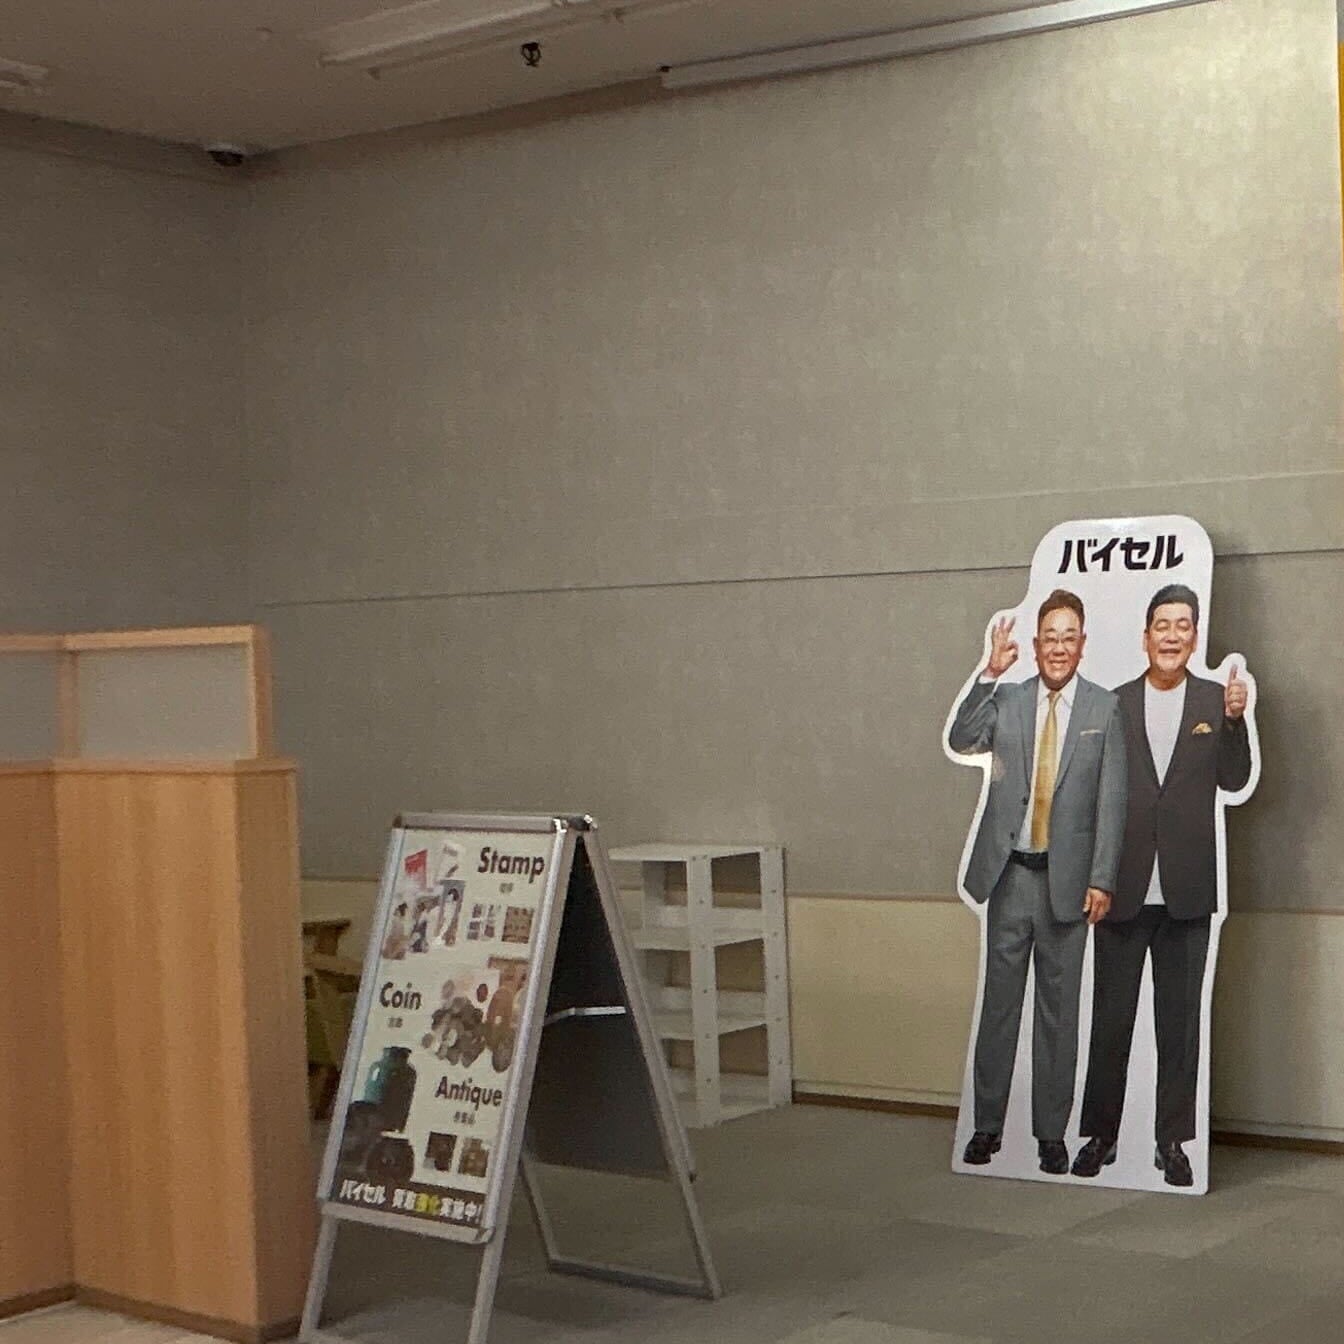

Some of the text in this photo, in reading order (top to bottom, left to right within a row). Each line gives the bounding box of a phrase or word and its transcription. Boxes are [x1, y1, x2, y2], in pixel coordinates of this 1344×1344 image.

[1058, 535, 1183, 573] バイセル
[477, 847, 545, 883] Stamp
[379, 981, 422, 1011] Coin
[435, 1076, 504, 1111] Antique
[340, 1179, 386, 1205] バイセル
